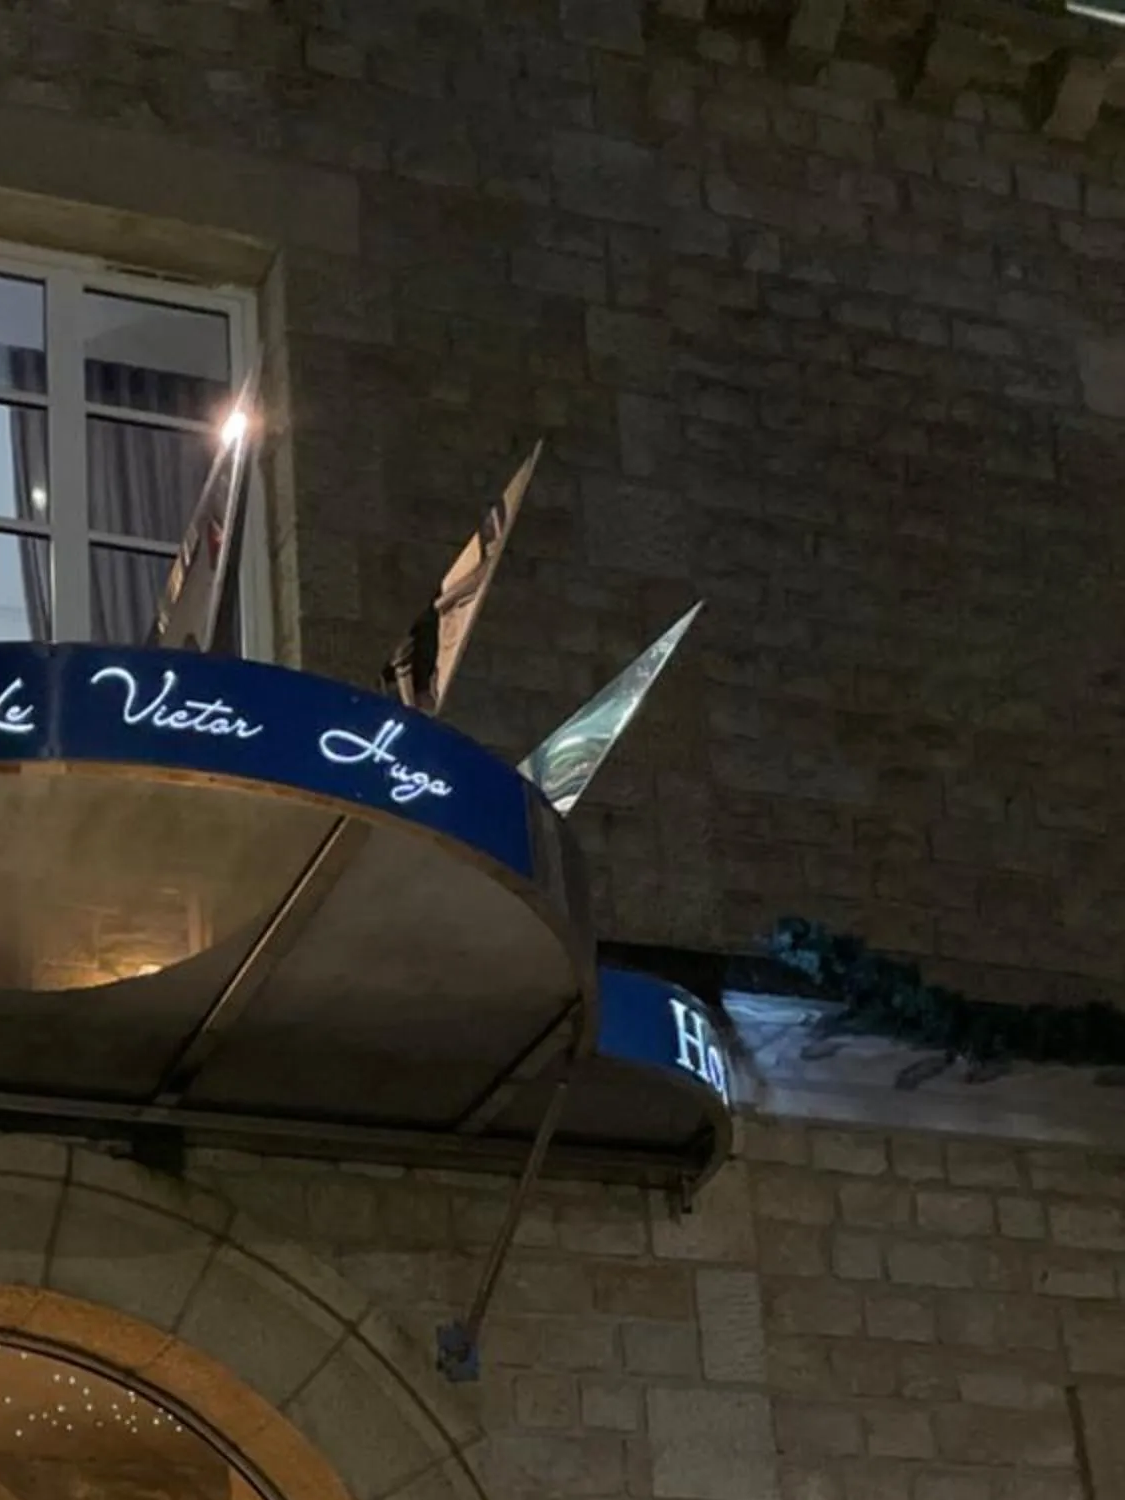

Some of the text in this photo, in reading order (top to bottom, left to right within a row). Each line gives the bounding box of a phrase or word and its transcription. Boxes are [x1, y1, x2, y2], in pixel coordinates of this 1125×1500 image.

[90, 666, 265, 739] Victor
[319, 718, 452, 803] Hugo
[669, 998, 729, 1106] Ho
